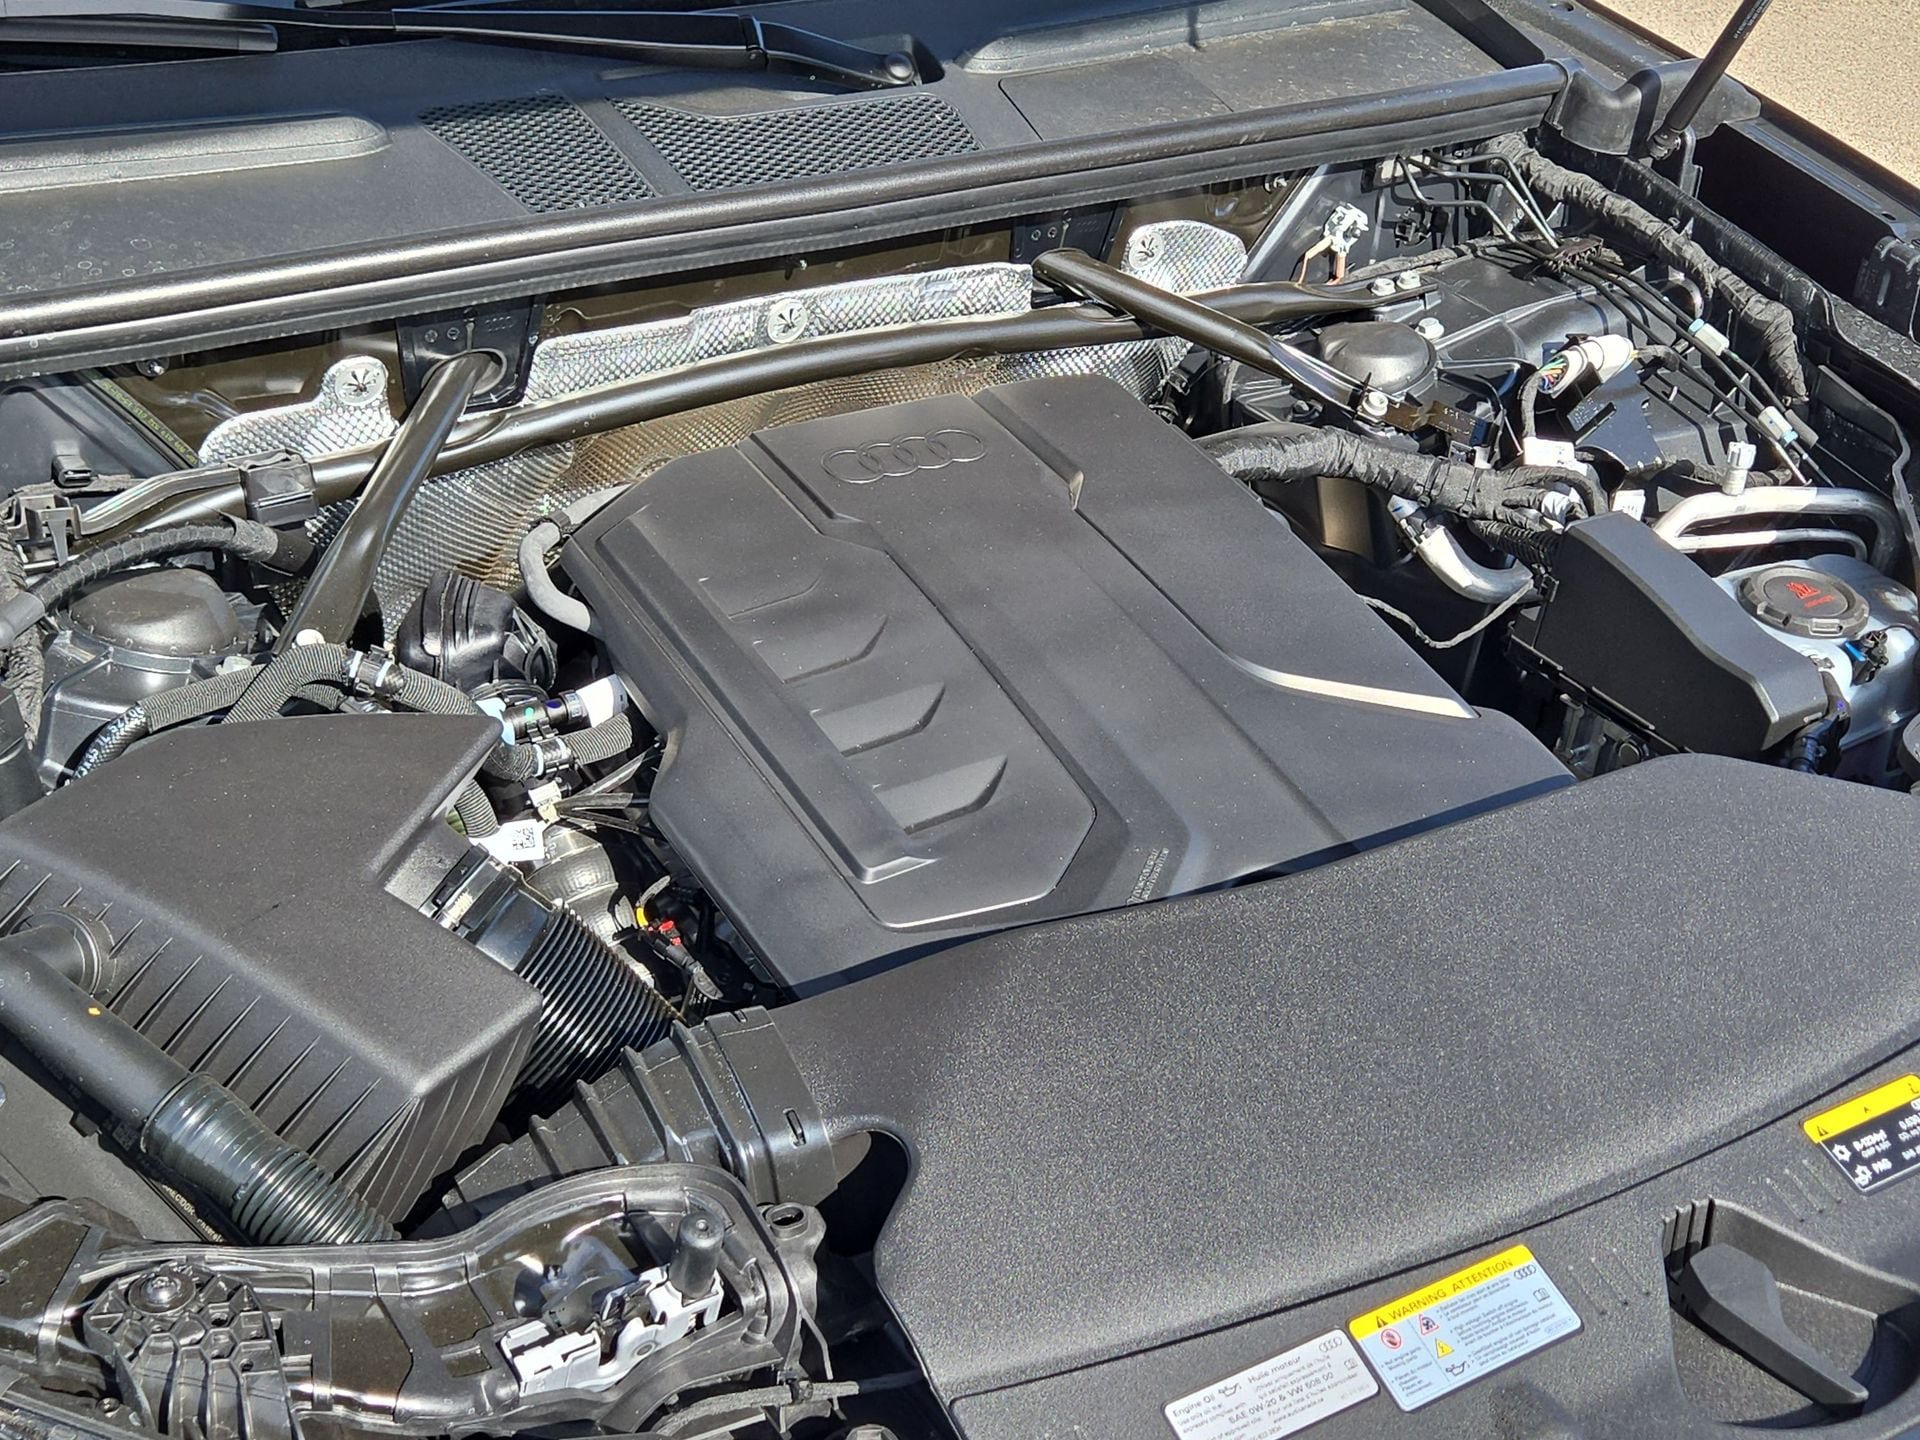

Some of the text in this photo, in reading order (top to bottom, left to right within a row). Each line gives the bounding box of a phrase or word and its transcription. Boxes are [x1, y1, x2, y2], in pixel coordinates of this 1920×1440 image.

[1389, 1289, 1447, 1321] WARNING
[1452, 1259, 1513, 1293] ATTENTION
[1248, 1371, 1270, 1384] Huile
[1271, 1356, 1301, 1374] moteur
[1287, 1385, 1304, 1397] VW
[1173, 1393, 1216, 1417] Engine Oil
